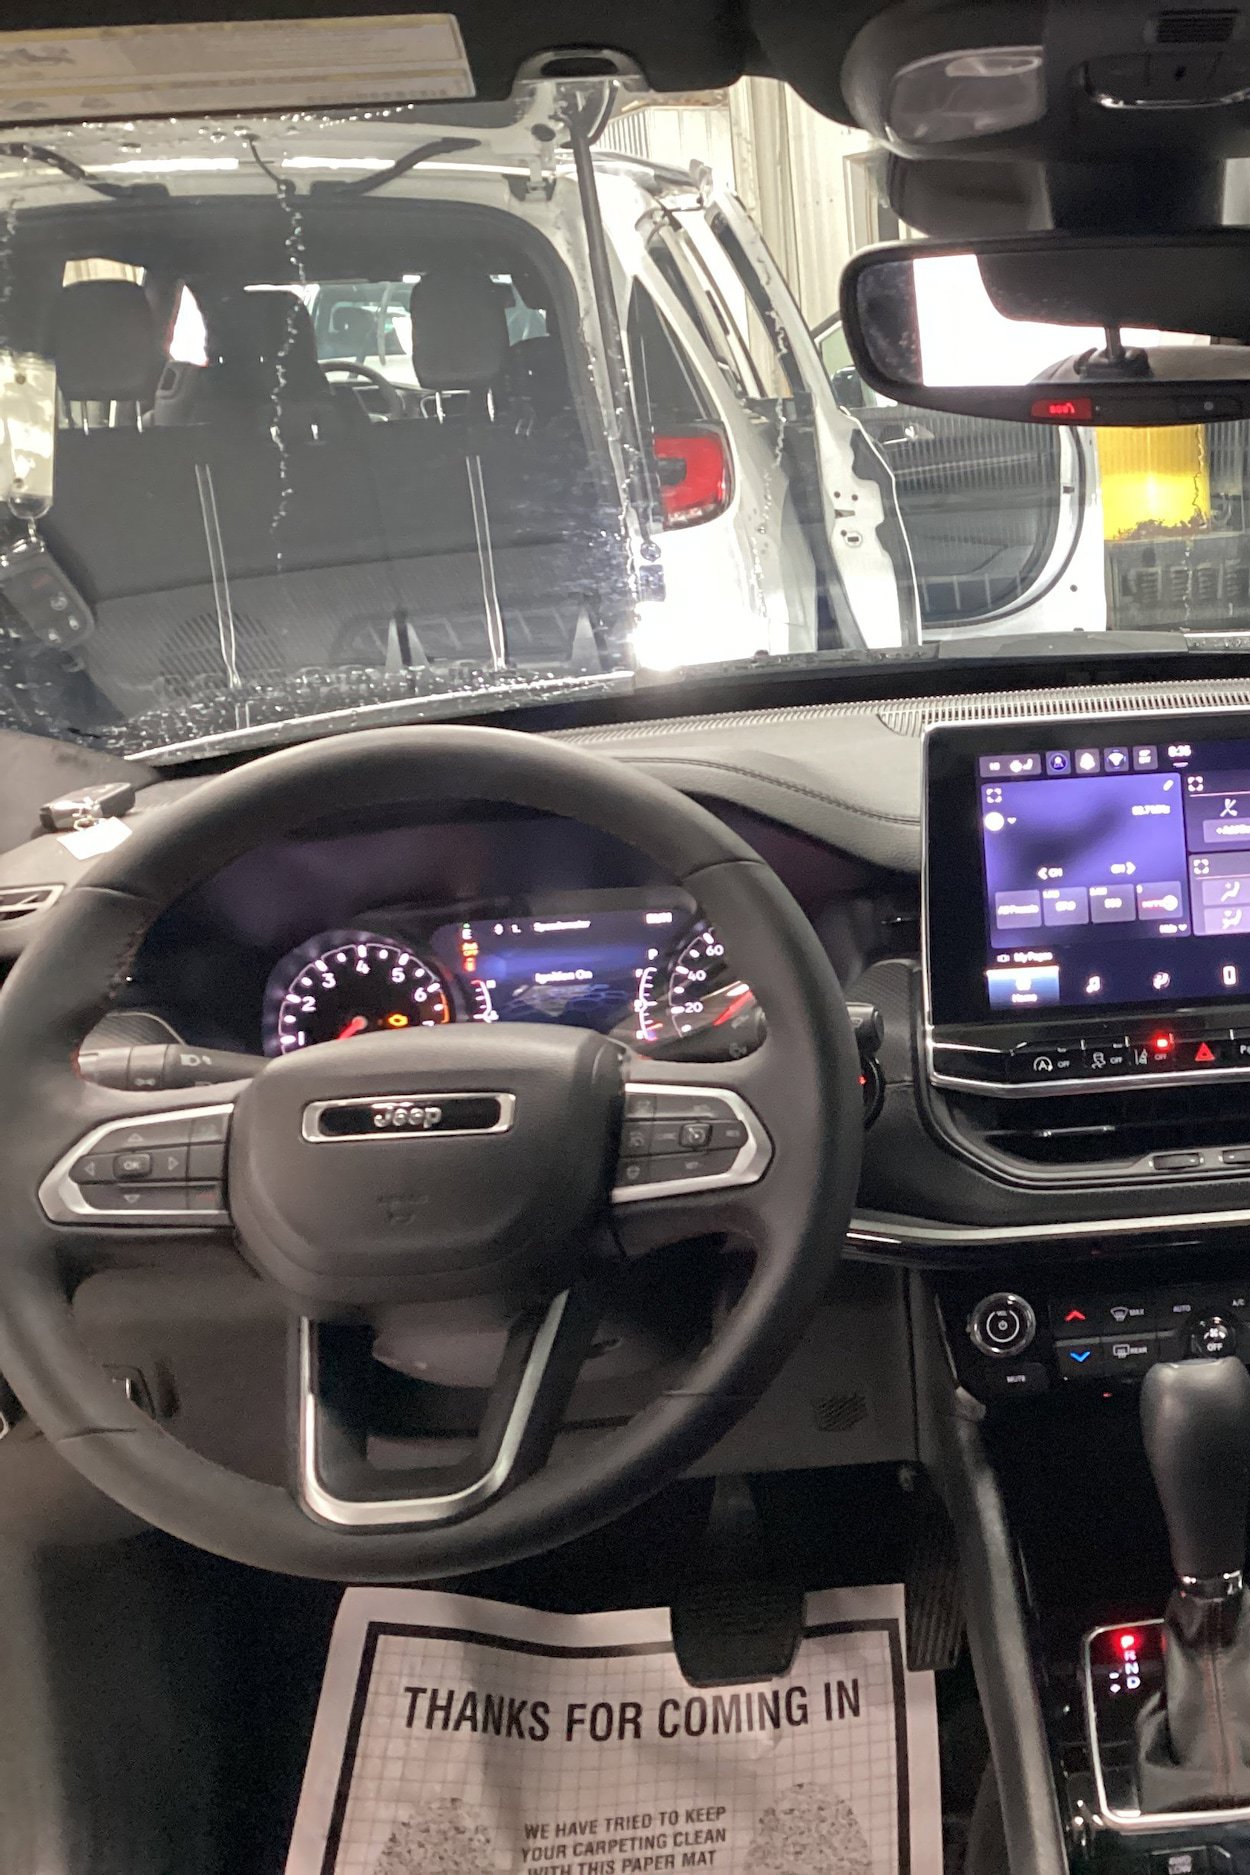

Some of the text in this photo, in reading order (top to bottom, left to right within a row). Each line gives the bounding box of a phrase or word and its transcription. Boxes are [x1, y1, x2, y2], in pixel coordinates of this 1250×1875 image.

[706, 944, 725, 957] 60
[356, 959, 370, 975] 4
[322, 972, 336, 989] 3
[391, 967, 405, 983] 5
[687, 969, 707, 981] 40
[414, 987, 427, 1002] 6
[301, 996, 316, 1012] 2
[684, 1001, 703, 1013] 20
[297, 1031, 305, 1046] 1
[1057, 1060, 1070, 1069] OFF
[1110, 1056, 1123, 1065] OFF
[373, 1106, 442, 1129] Jeep
[123, 1159, 140, 1171] OK
[1173, 1305, 1191, 1313] AUTO
[1207, 1343, 1223, 1352] OFF
[1121, 1635, 1135, 1649] P
[1125, 1661, 1139, 1675] N
[1127, 1675, 1141, 1690] D
[404, 1678, 860, 1742] THANKS FOR COMING IN
[524, 1805, 727, 1840] WE HAVE TRIED TO KEEP
[521, 1828, 727, 1864] YOUR CARPETING CLEAN
[528, 1849, 717, 1875] WITH THIS PAPER MAT
